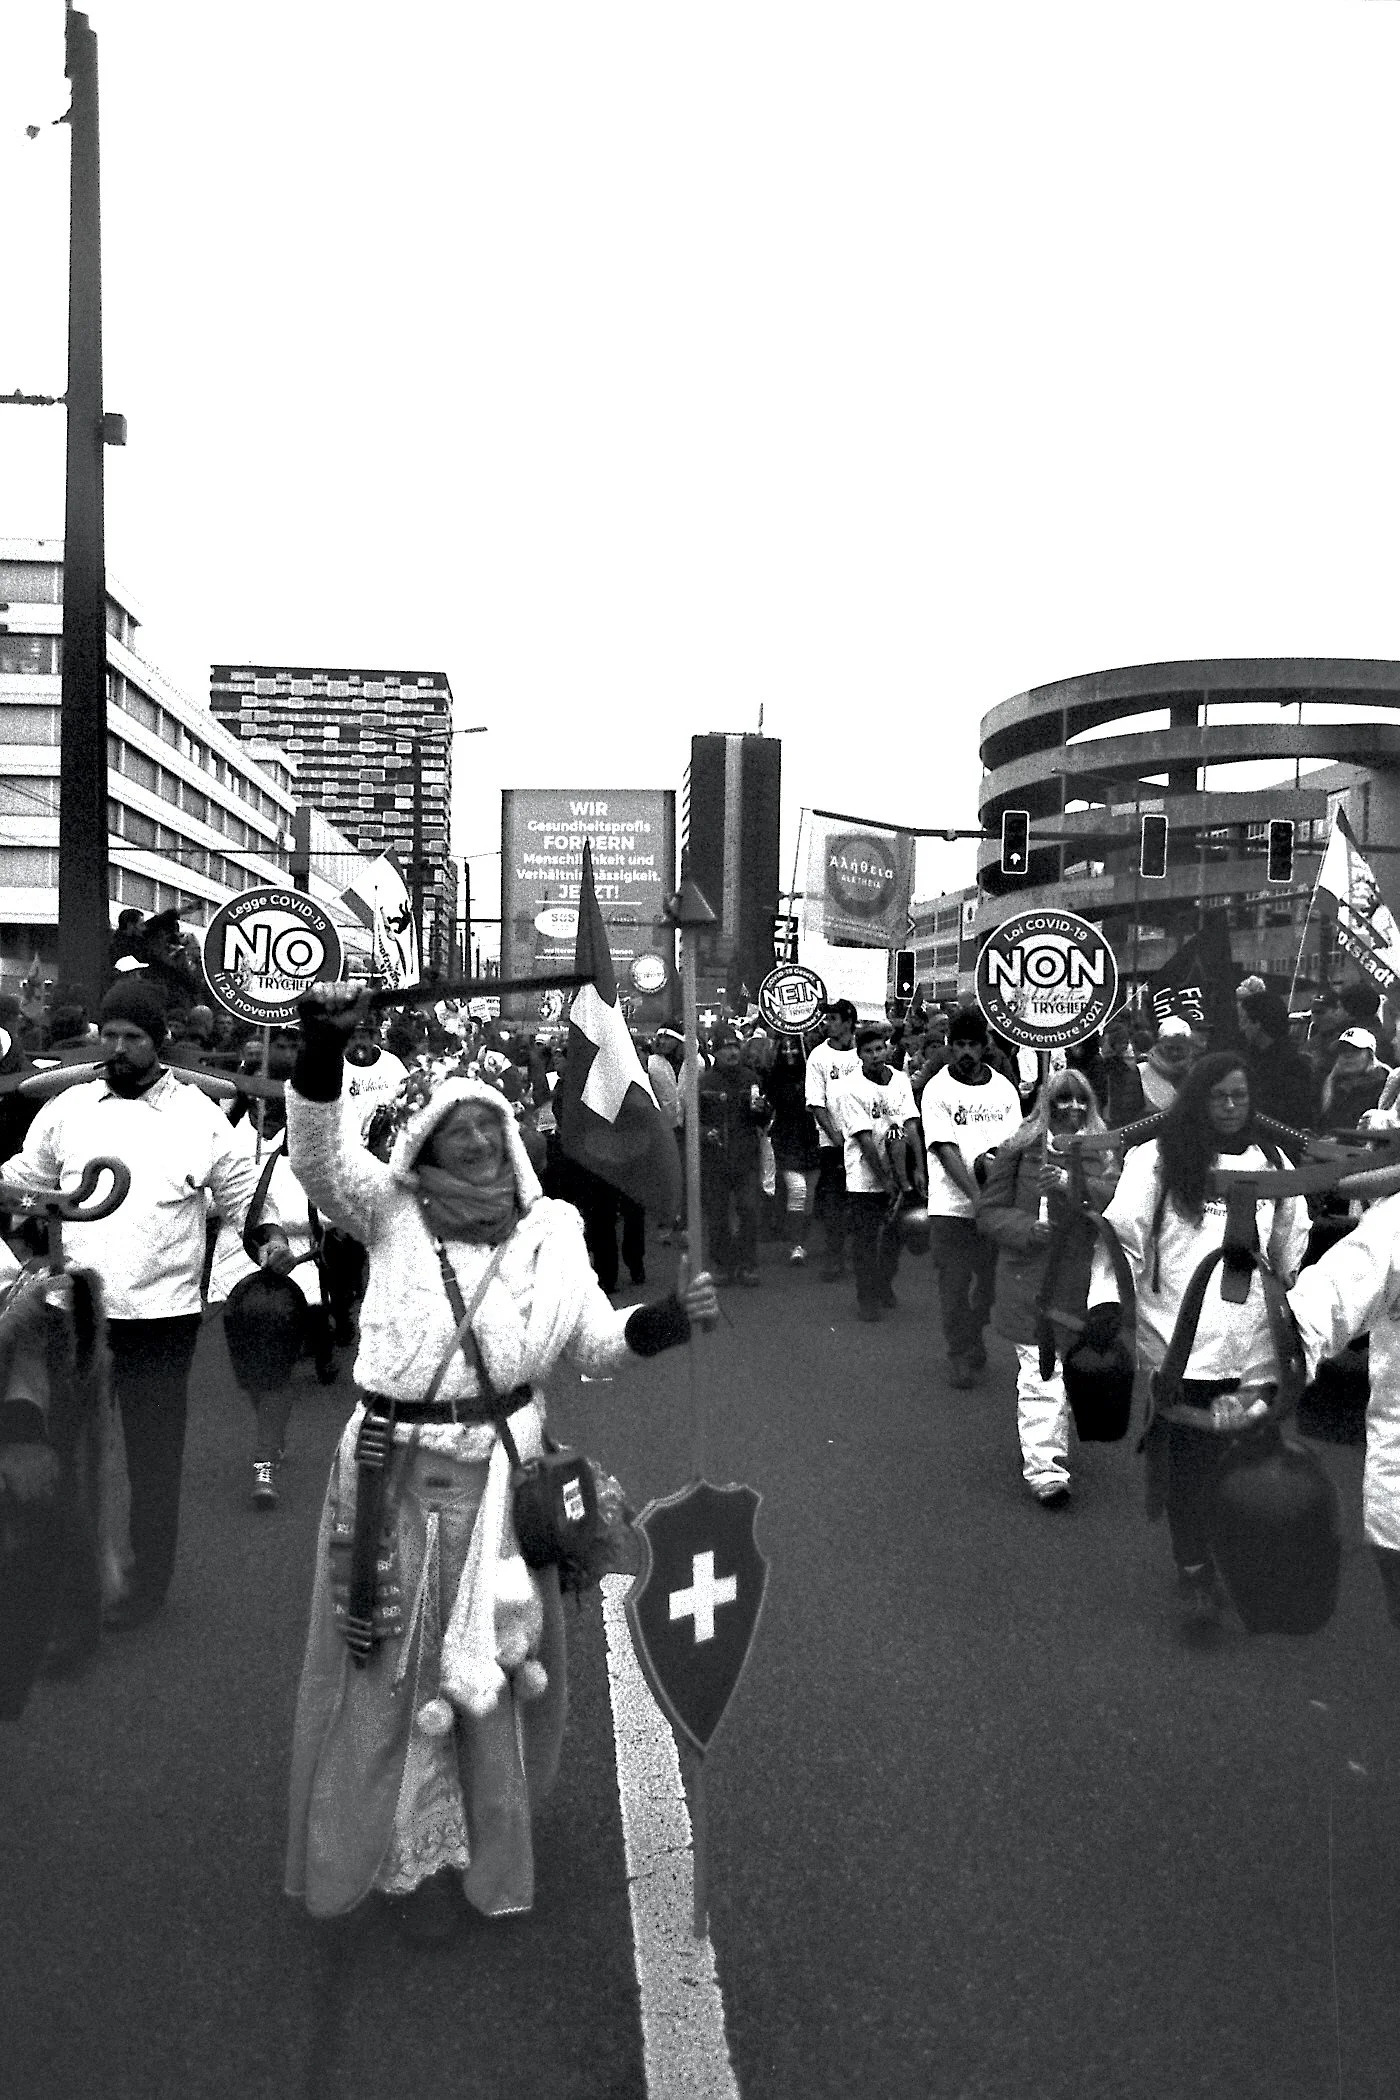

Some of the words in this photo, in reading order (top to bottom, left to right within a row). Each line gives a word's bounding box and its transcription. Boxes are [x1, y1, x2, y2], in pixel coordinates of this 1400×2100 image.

[569, 801, 609, 816] WIR
[527, 820, 652, 834] Gesundheitsprofis
[523, 853, 626, 866] Menschlihkeit
[628, 854, 654, 866] und
[516, 869, 662, 884] Verhältnimässigkeit.
[558, 884, 620, 899] JEZT!
[228, 896, 267, 919] Legge
[270, 894, 326, 931] COVID-19
[1003, 923, 1024, 941] Loi
[1025, 918, 1088, 941] COVID-19
[222, 924, 326, 979] NO
[987, 946, 1105, 988] NON
[220, 983, 236, 999] 28
[234, 998, 299, 1018] novembr
[763, 980, 824, 1008] NEIN
[988, 1000, 998, 1012] le
[996, 1012, 1012, 1028] 28
[1012, 1026, 1080, 1043] novembre
[1080, 1000, 1104, 1028] 2021
